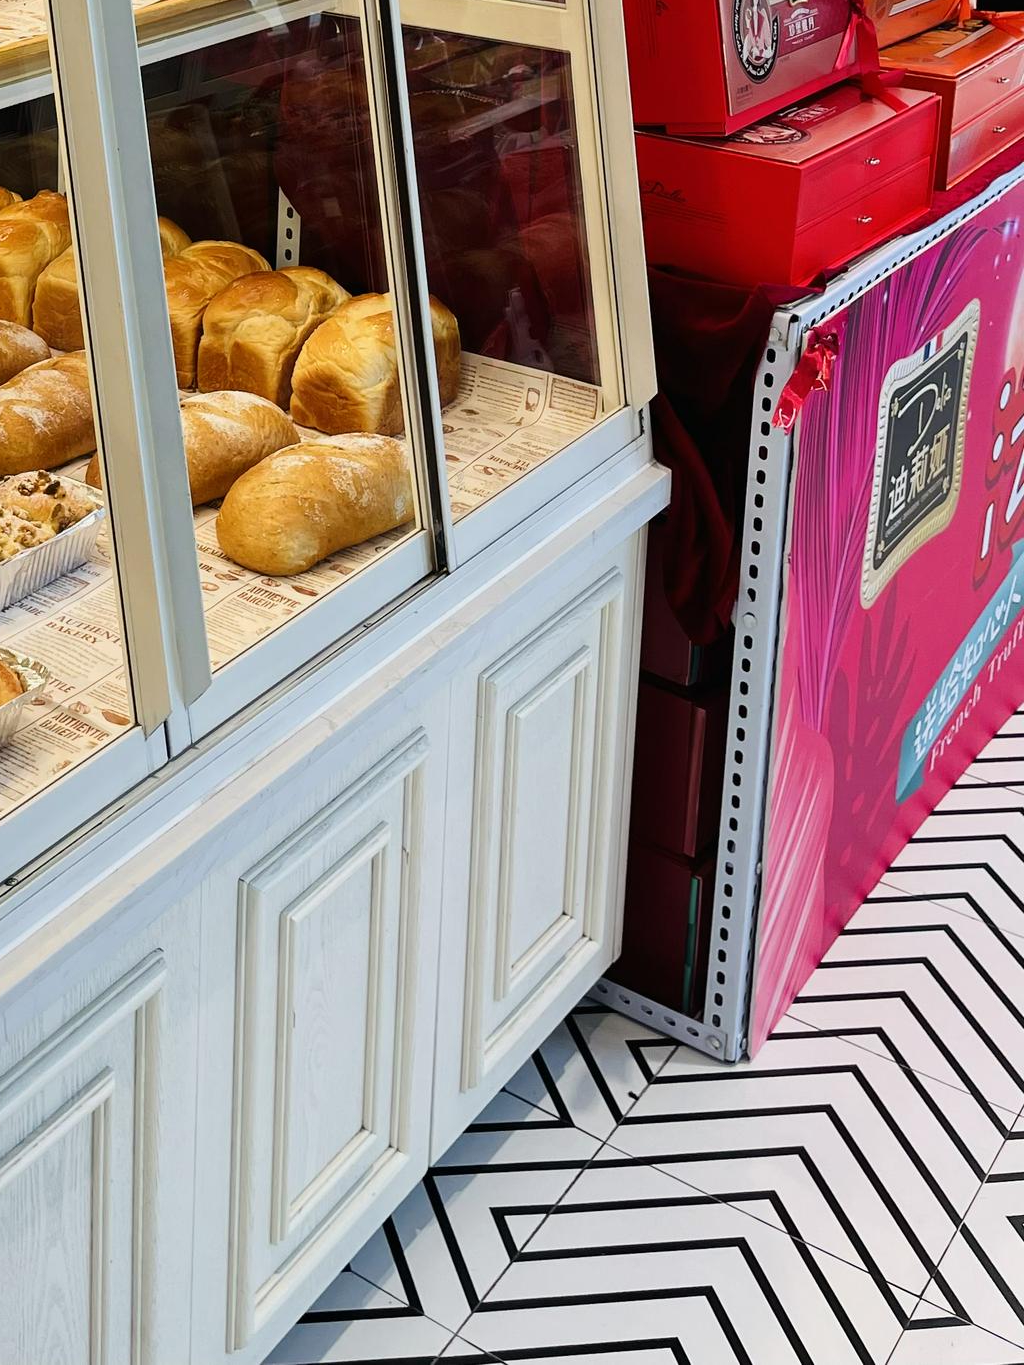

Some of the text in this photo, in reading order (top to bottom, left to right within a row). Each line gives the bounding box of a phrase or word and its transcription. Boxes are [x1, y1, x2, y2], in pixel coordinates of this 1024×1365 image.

[897, 372, 952, 457] Delia
[237, 591, 279, 610] BAKERY
[247, 586, 302, 609] AUTHENTIC
[45, 621, 101, 644] BAKERY
[56, 614, 121, 645] AUTHENT
[39, 719, 83, 741] BAKERY
[52, 711, 110, 742] AUTHENTIC
[929, 683, 982, 773] French
